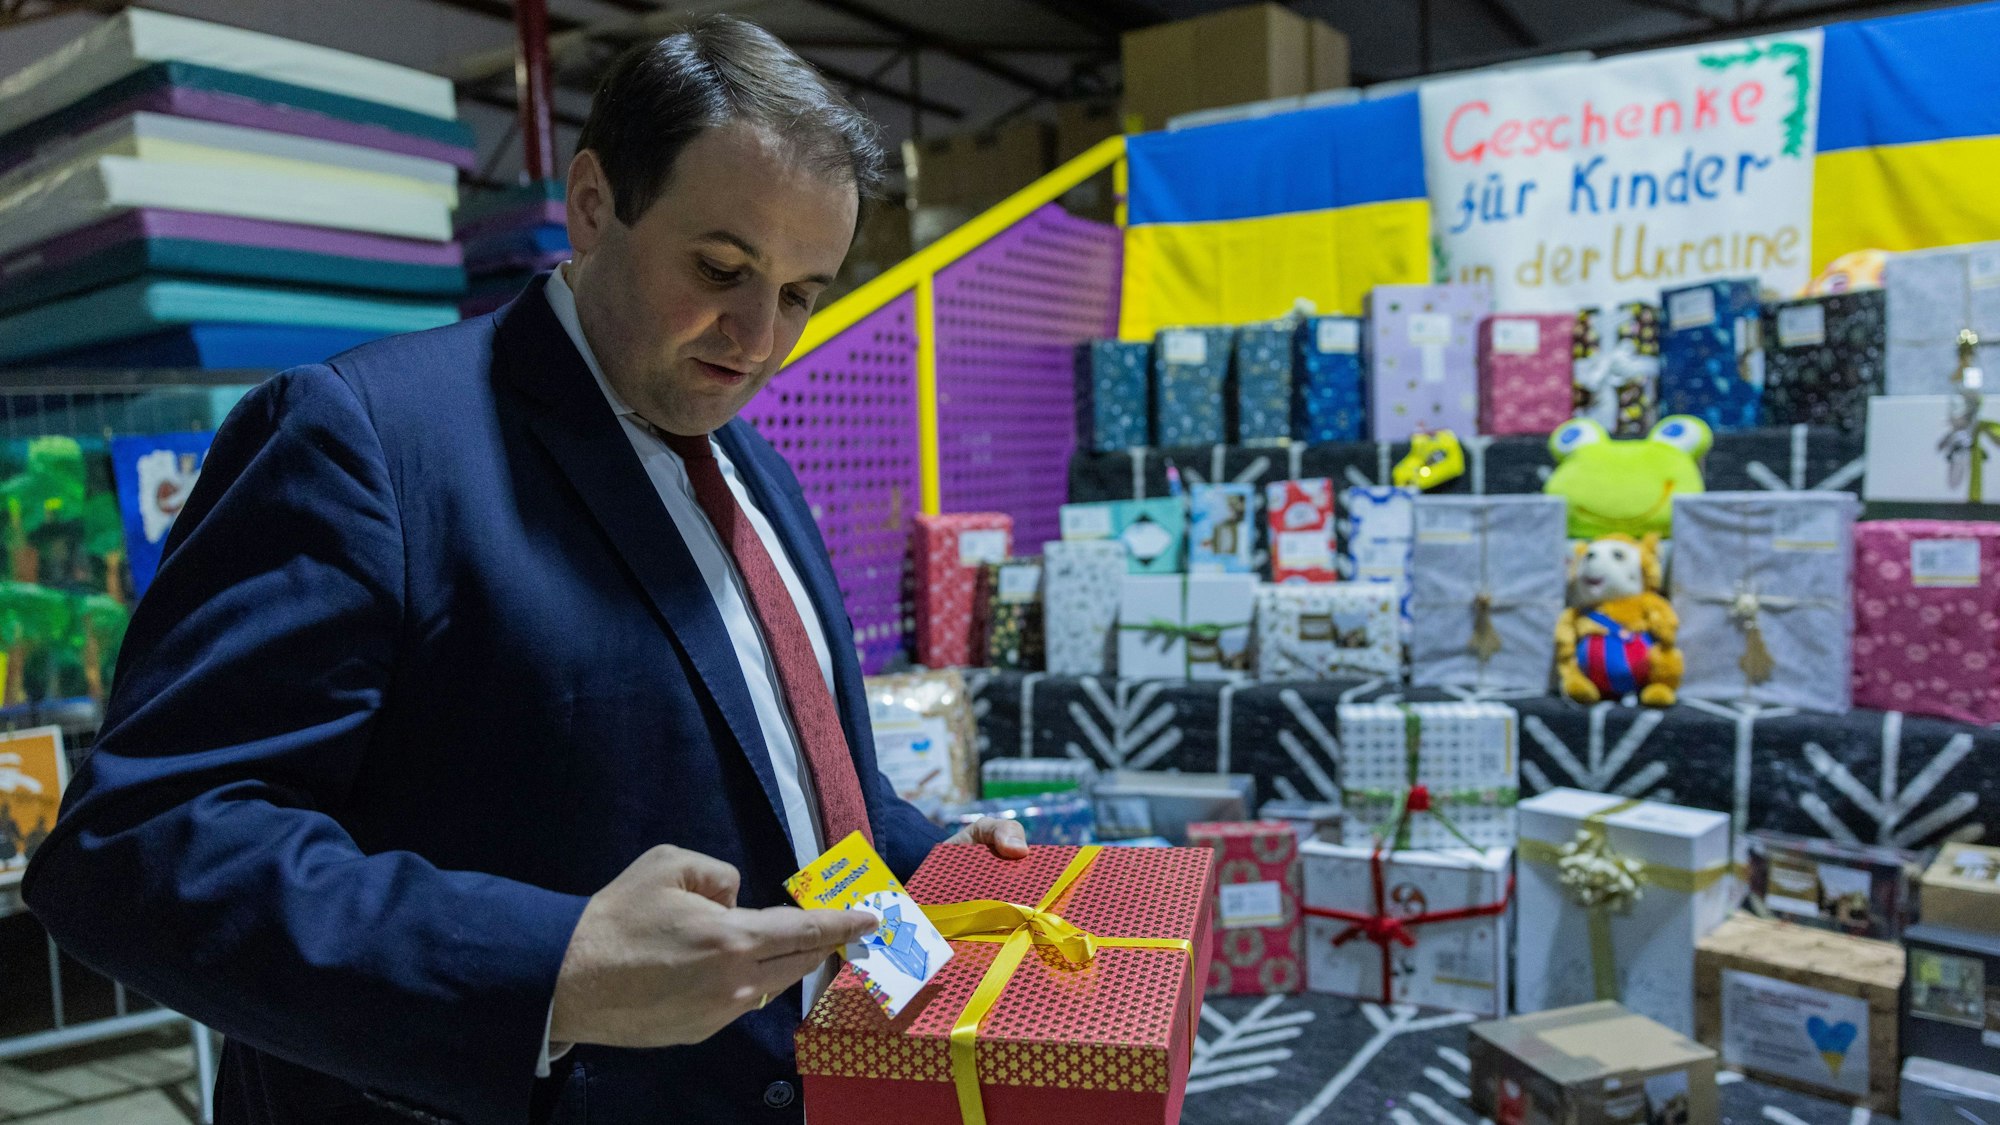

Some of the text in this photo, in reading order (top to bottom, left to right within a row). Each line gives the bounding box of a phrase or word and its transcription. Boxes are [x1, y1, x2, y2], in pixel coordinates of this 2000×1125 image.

[1445, 81, 1764, 163] Geschenke
[1449, 149, 1769, 234] für Kinder
[1514, 240, 1600, 288] der
[1612, 224, 1799, 282] Ukraine
[821, 857, 849, 881] Aktion
